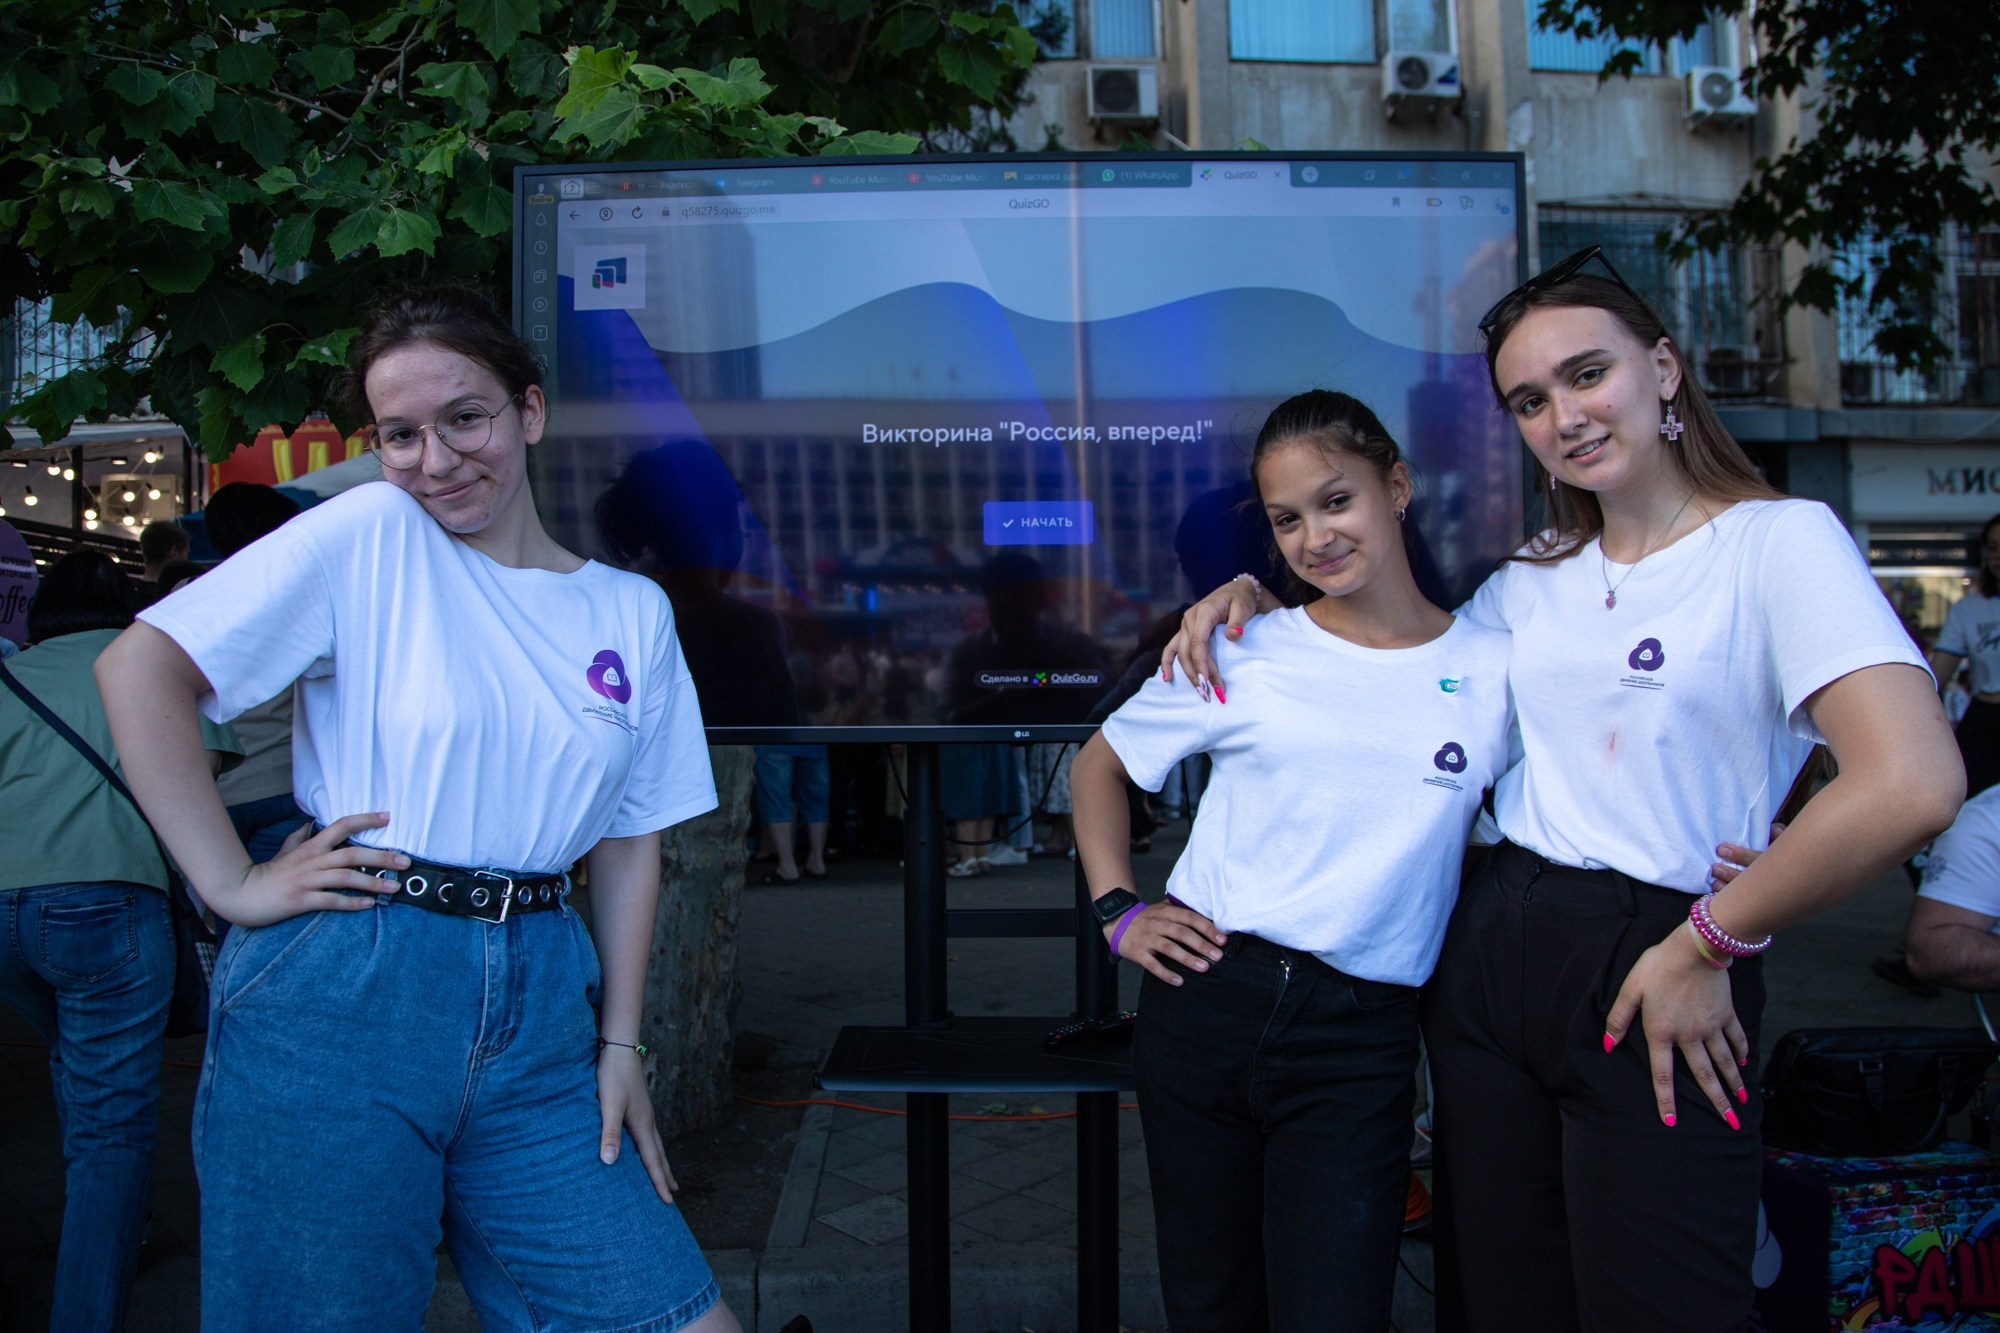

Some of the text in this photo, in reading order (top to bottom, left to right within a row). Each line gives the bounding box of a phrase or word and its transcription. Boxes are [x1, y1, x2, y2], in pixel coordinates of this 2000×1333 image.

[829, 175, 866, 185] YouTube
[926, 173, 963, 183] YouTube
[1134, 171, 1180, 182] WhatsApp
[1224, 170, 1258, 181] QuizGO
[737, 178, 775, 190] Telegram
[1008, 199, 1051, 210] QuizGO
[681, 204, 776, 219] q58275.quizgo.me
[862, 420, 1214, 448] Викторина "Россия, вперед!"
[1021, 517, 1074, 528] НАЧАТЬ
[980, 674, 1021, 683] Сделано
[1051, 673, 1098, 684] QuizGo.ru
